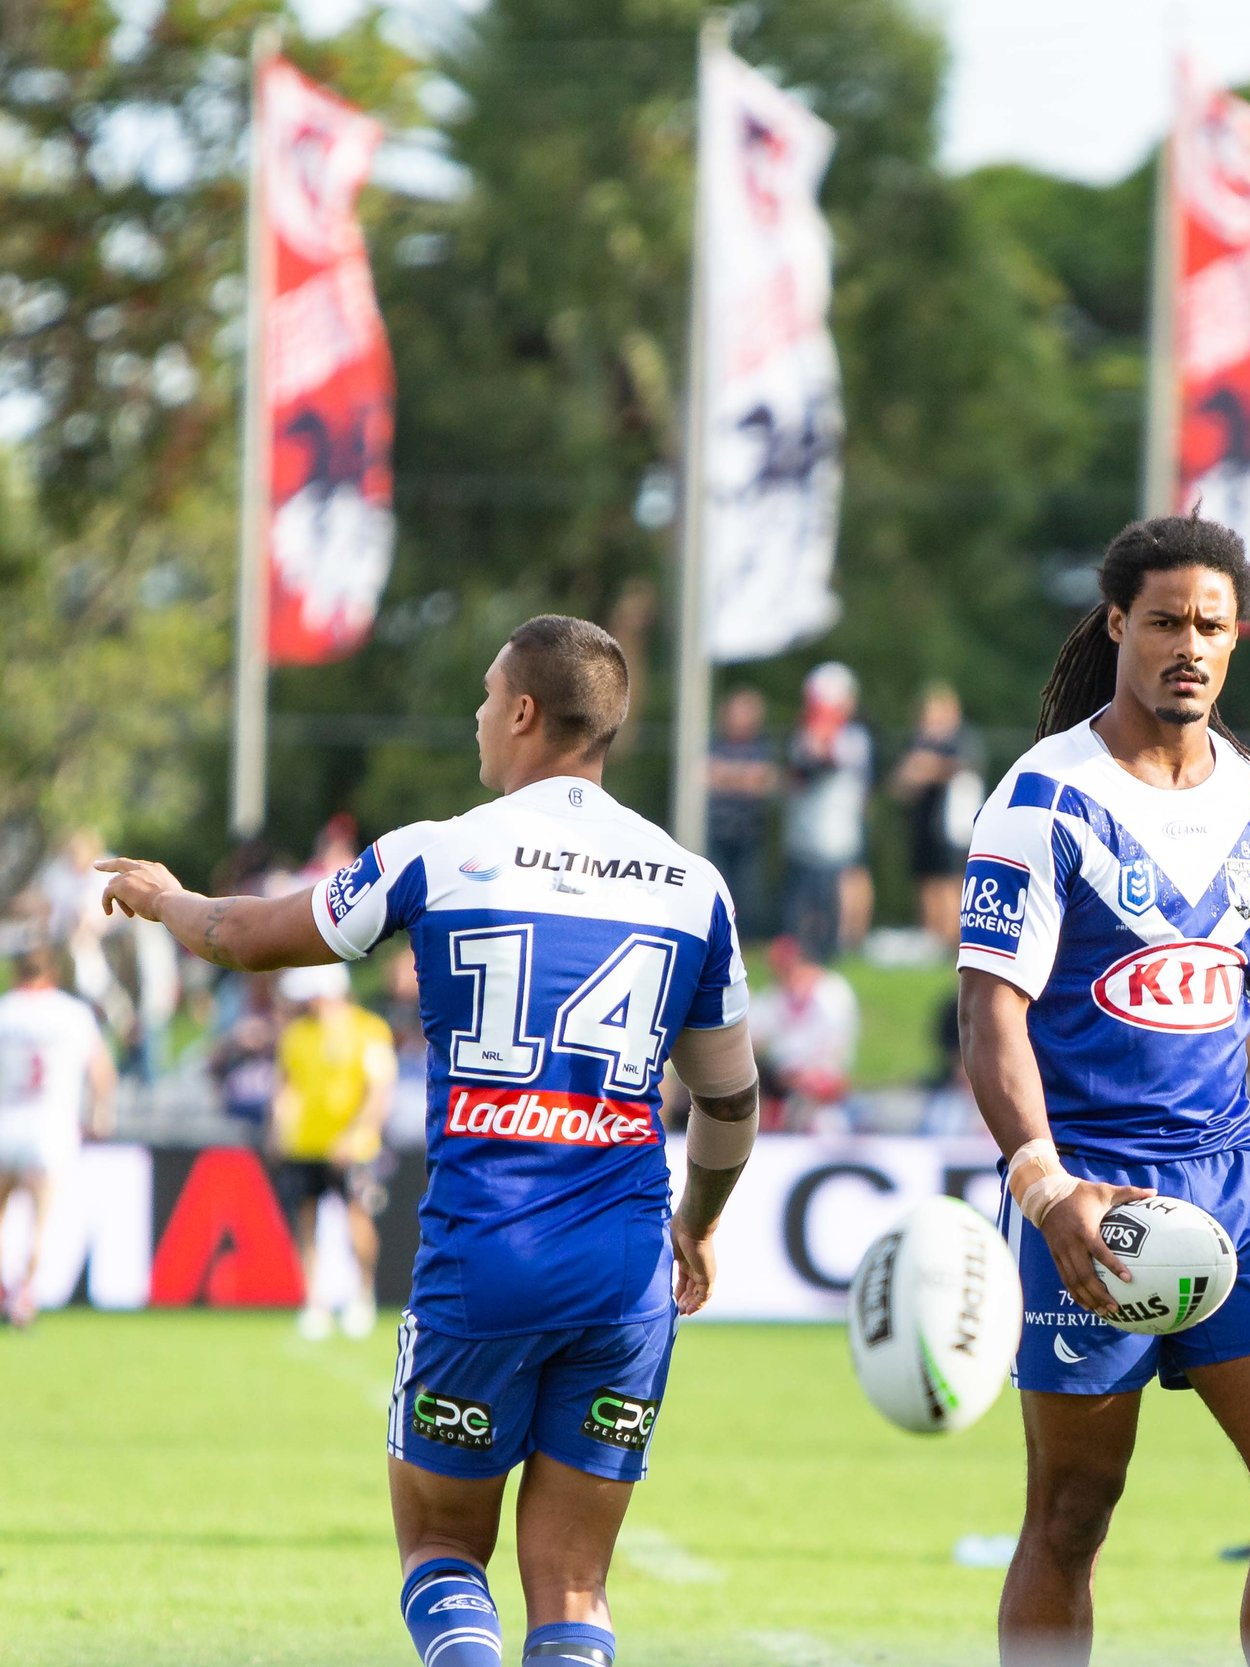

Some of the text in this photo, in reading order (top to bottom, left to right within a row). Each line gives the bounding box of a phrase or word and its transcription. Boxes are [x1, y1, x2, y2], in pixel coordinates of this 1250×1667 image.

[514, 846, 686, 887] ULTIMATE
[449, 923, 678, 1096] 14
[481, 1050, 503, 1061] NRL
[622, 1063, 639, 1075] NRL
[450, 1091, 651, 1143] Ladbrokes
